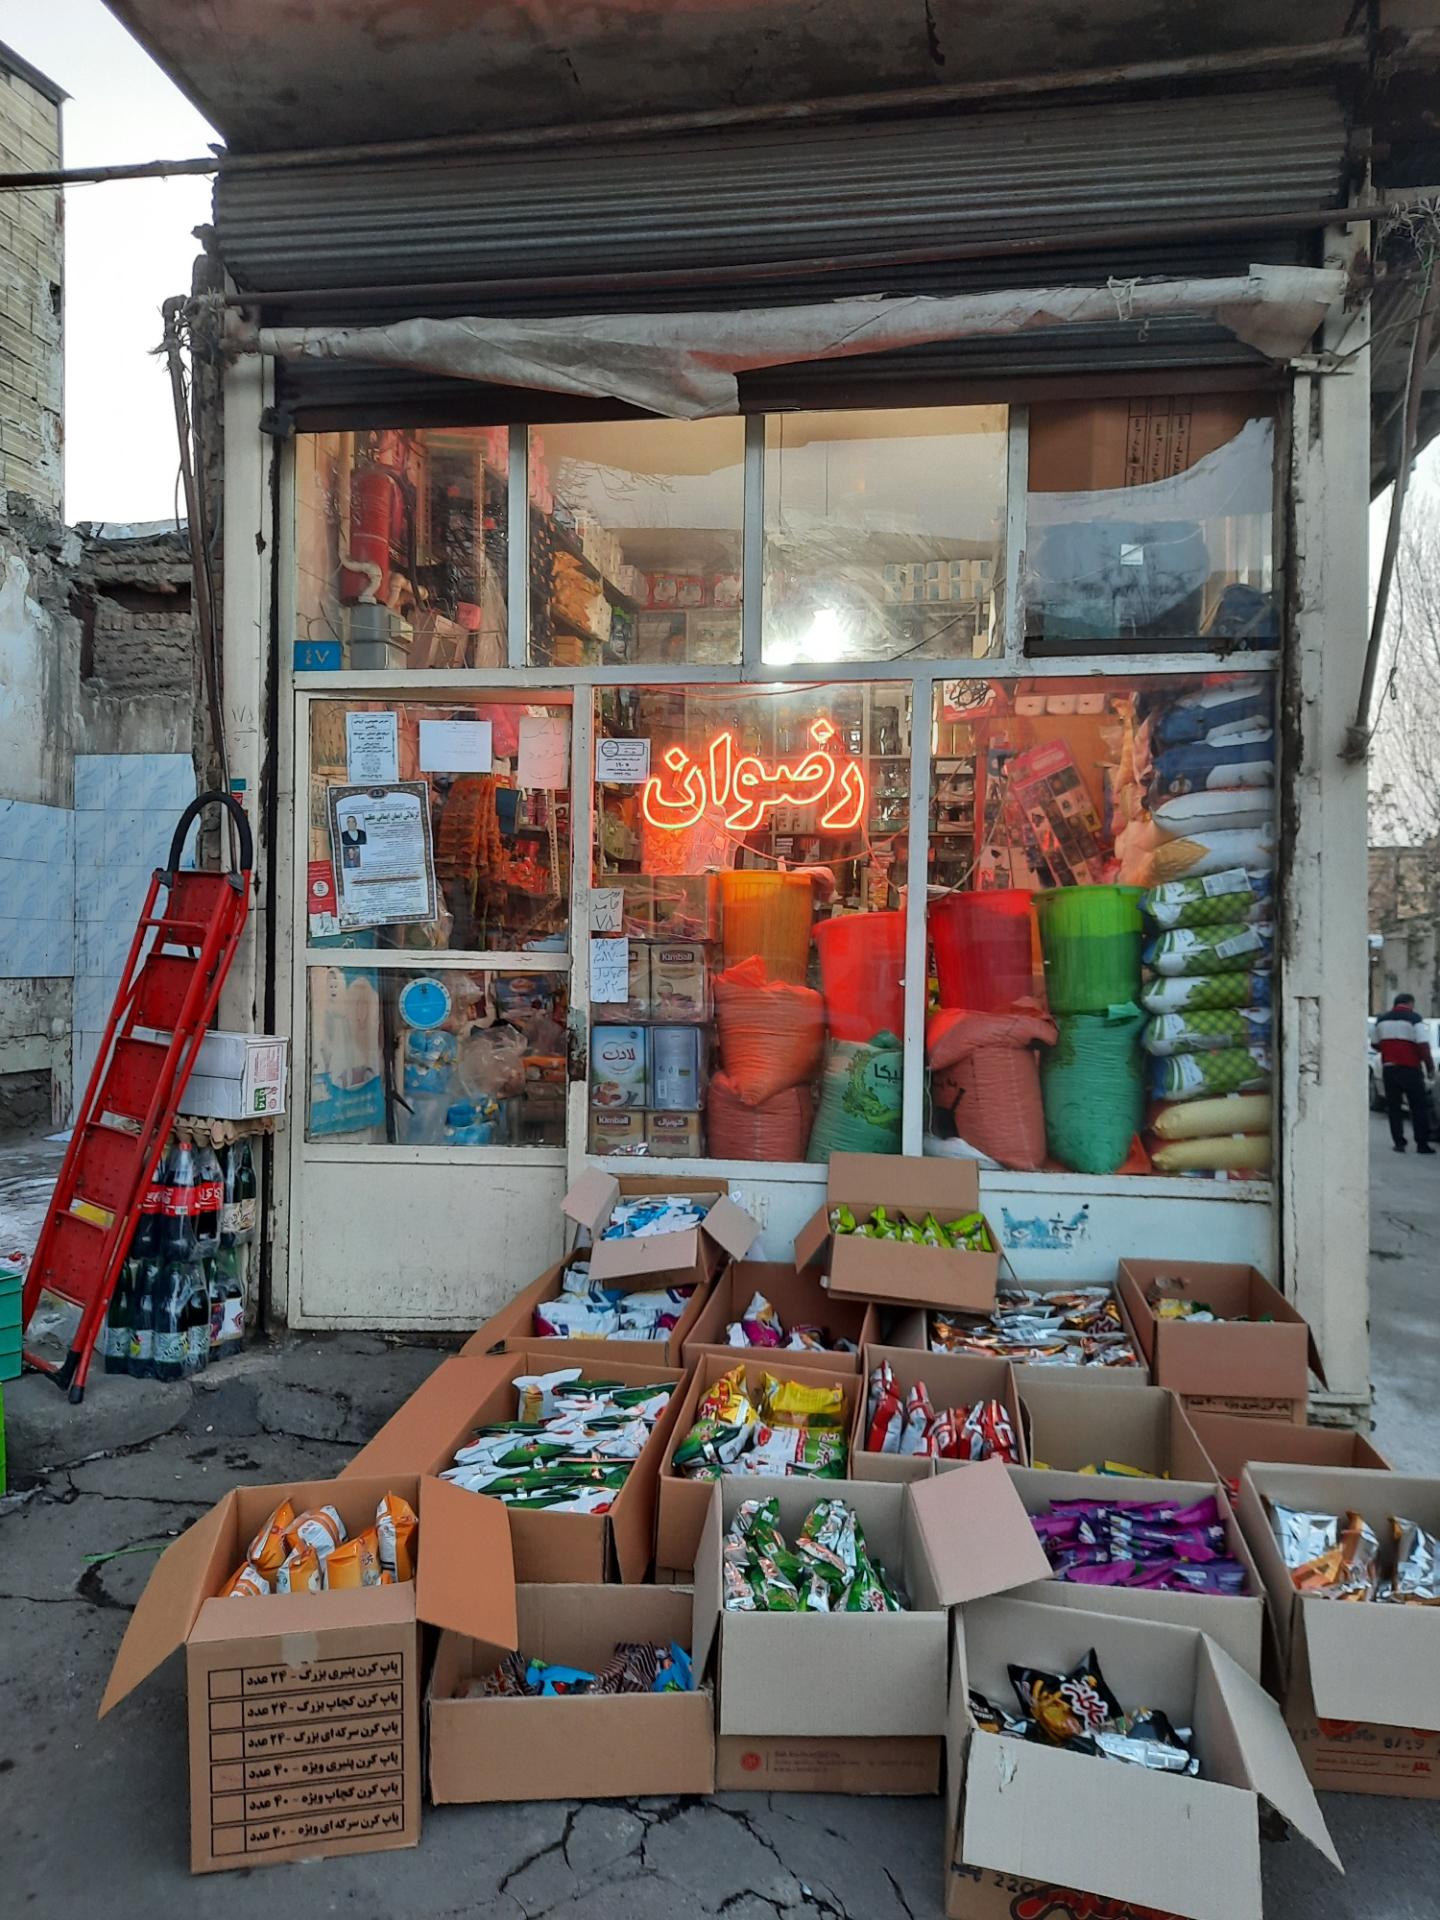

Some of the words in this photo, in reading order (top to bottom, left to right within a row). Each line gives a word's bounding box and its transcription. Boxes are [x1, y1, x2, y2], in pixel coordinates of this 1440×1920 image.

[643, 718, 866, 830] رضوان
[661, 951, 693, 961] Kimball
[602, 1048, 636, 1061] لادن
[598, 1116, 629, 1125] Kimball
[299, 1668, 326, 1682] بزرگ
[329, 1666, 355, 1680] پنیری
[358, 1663, 378, 1678] کرن
[380, 1661, 398, 1676] پاپ
[247, 1675, 268, 1686] عدد
[271, 1670, 286, 1683] ۲۴
[327, 1696, 355, 1710] کچاپ
[358, 1694, 378, 1708] کرن
[380, 1691, 398, 1706] پاپ
[247, 1706, 268, 1717] عدد
[271, 1701, 287, 1714] ۲۴
[297, 1699, 324, 1713] بزرگ
[335, 1727, 359, 1740] سرکه
[360, 1723, 379, 1738] کرن
[381, 1721, 398, 1735] پاپ
[248, 1737, 267, 1748] عدد
[271, 1732, 286, 1744] ۲۴
[294, 1732, 320, 1745] بزرگ
[321, 1730, 334, 1742] ای
[357, 1754, 377, 1769] کرن
[380, 1751, 398, 1766] پاپ
[274, 1764, 288, 1776] ۴۰
[302, 1762, 324, 1774] ویژه
[327, 1758, 354, 1773] پنیری
[249, 1768, 271, 1779] عدد
[325, 1787, 354, 1801] کچاپ
[357, 1784, 378, 1799] کرن
[380, 1782, 398, 1796] پاپ
[249, 1799, 271, 1810] عدد
[274, 1794, 288, 1806] ۴۰
[301, 1793, 324, 1806] ویژه
[335, 1817, 359, 1830] سرکه
[360, 1814, 380, 1829] کرن
[382, 1811, 399, 1826] پاپ
[273, 1825, 286, 1837] ۴۰
[298, 1825, 319, 1836] ویژه
[321, 1821, 334, 1833] ای
[250, 1831, 270, 1842] عدد
